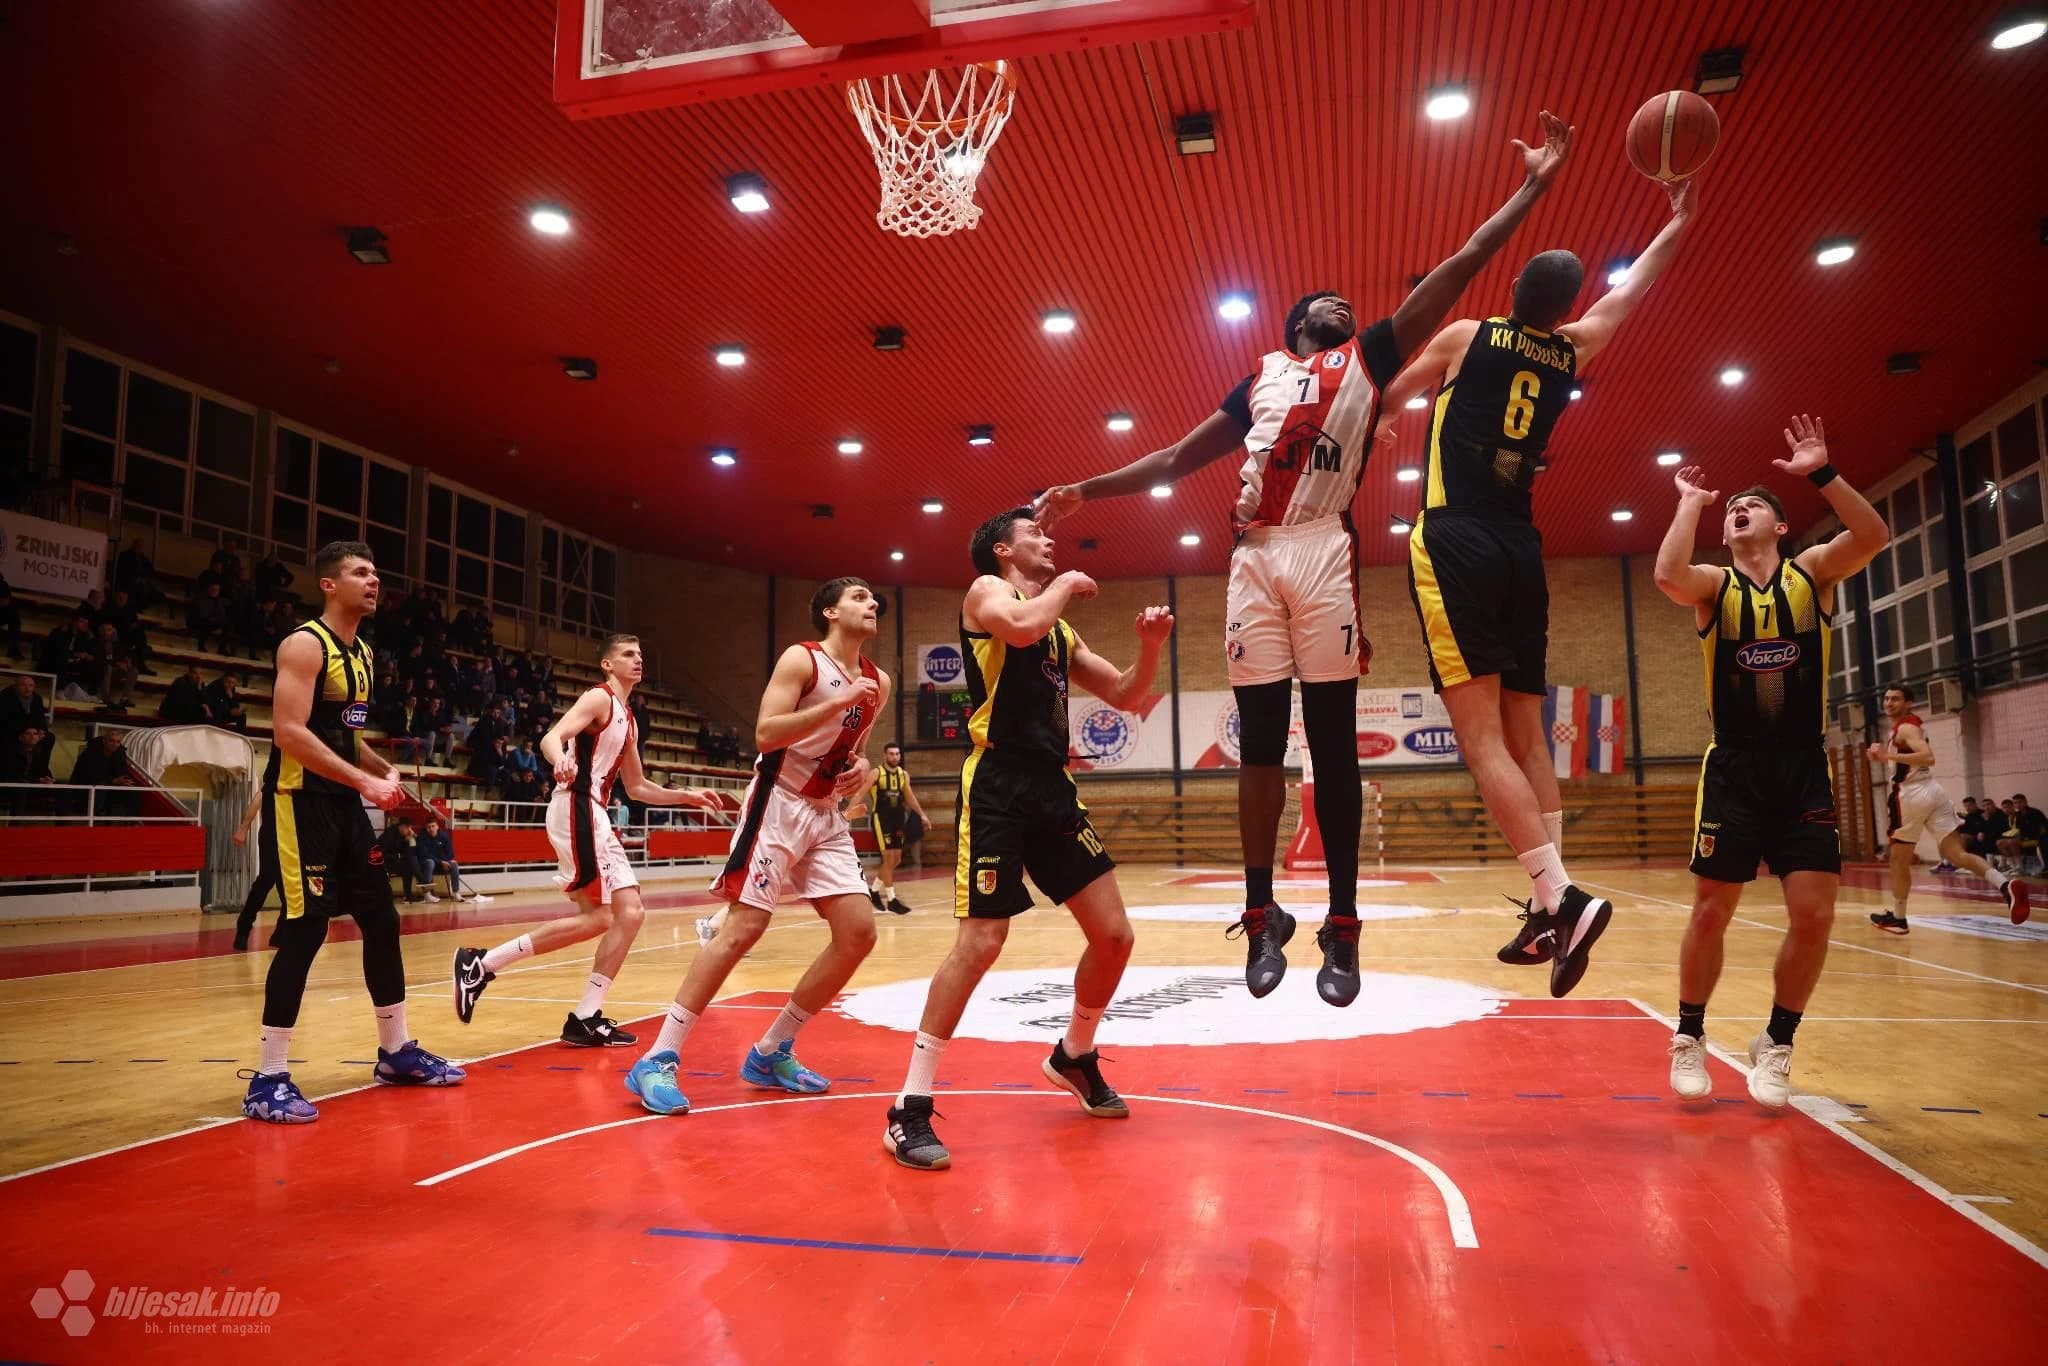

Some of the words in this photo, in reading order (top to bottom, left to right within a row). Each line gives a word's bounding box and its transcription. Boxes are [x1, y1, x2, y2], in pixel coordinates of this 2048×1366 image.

[1490, 327, 1515, 350] KK
[1297, 378, 1311, 402] 7
[1503, 370, 1541, 440] 6
[15, 534, 99, 568] ZRINJSKI
[23, 558, 89, 585] MOSTAR
[1759, 605, 1770, 629] 7
[1340, 624, 1353, 656] 7
[358, 671, 366, 693] 8
[842, 705, 863, 729] 25
[1077, 828, 1104, 857] 18
